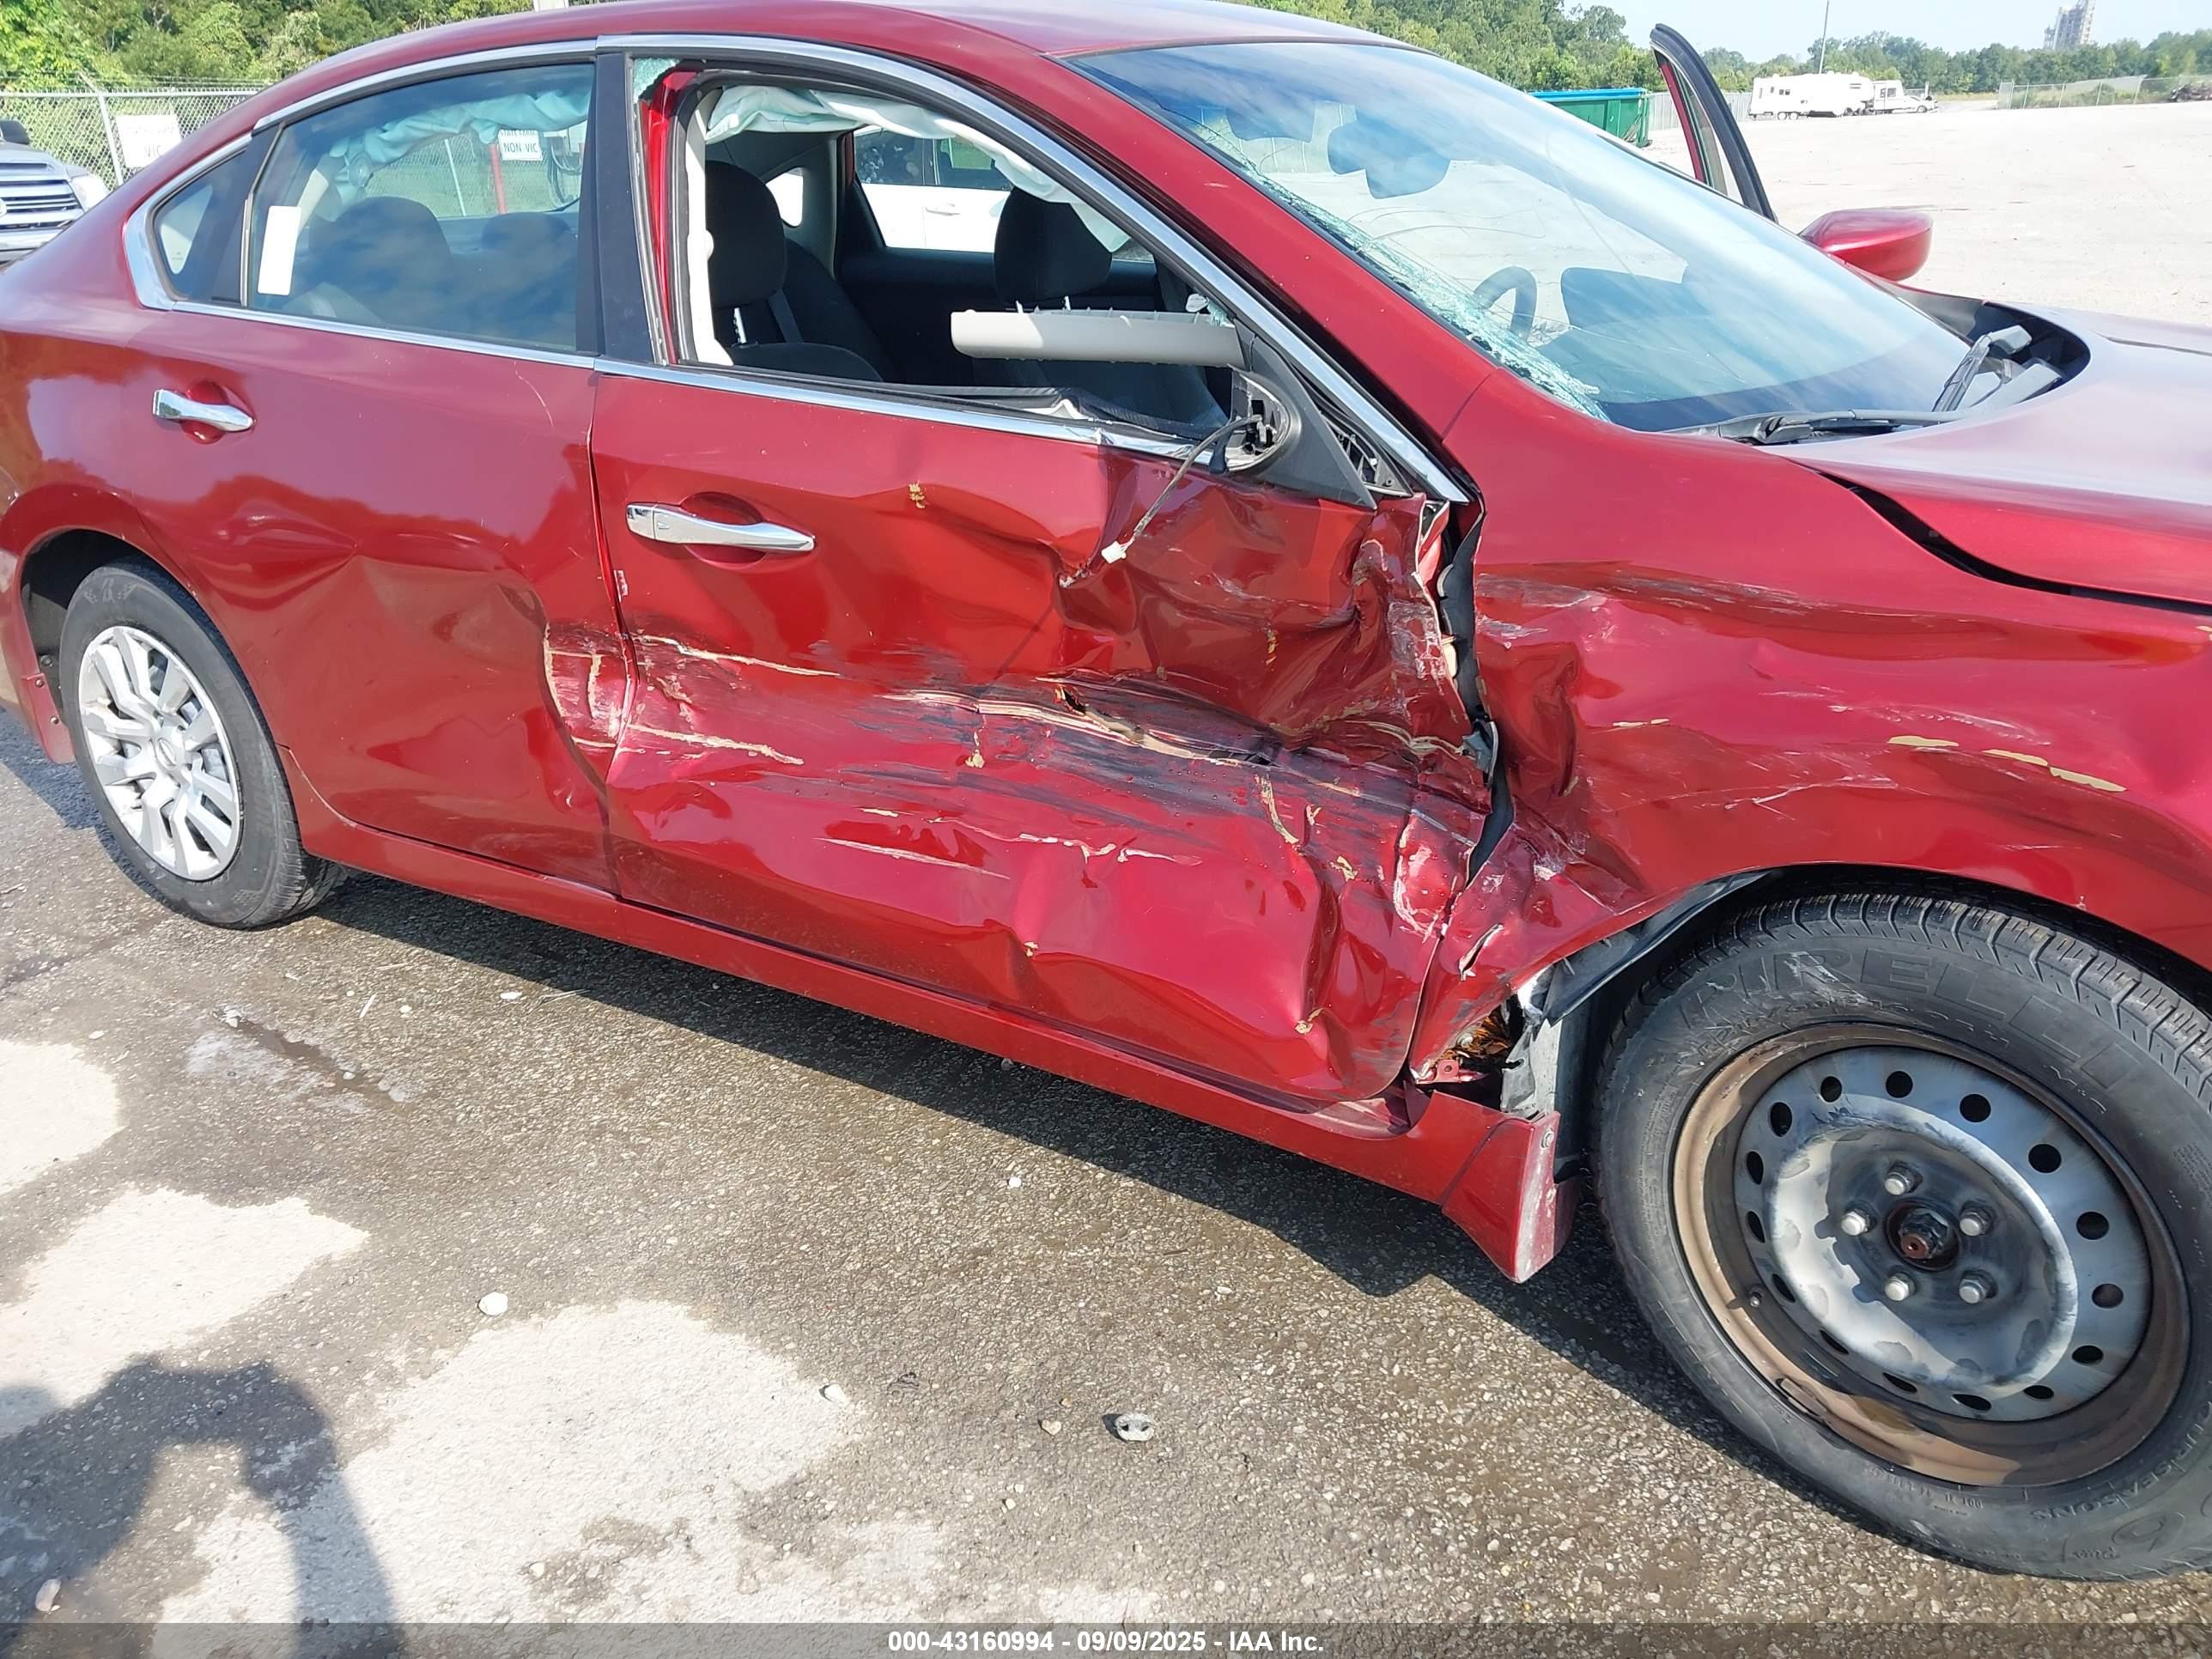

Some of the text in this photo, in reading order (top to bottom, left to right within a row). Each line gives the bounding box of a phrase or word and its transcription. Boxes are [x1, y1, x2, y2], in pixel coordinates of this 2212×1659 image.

[503, 142, 538, 153] NON VIC
[1674, 947, 2142, 1091] PIRELLI
[2028, 1457, 2173, 1522] SEASONS
